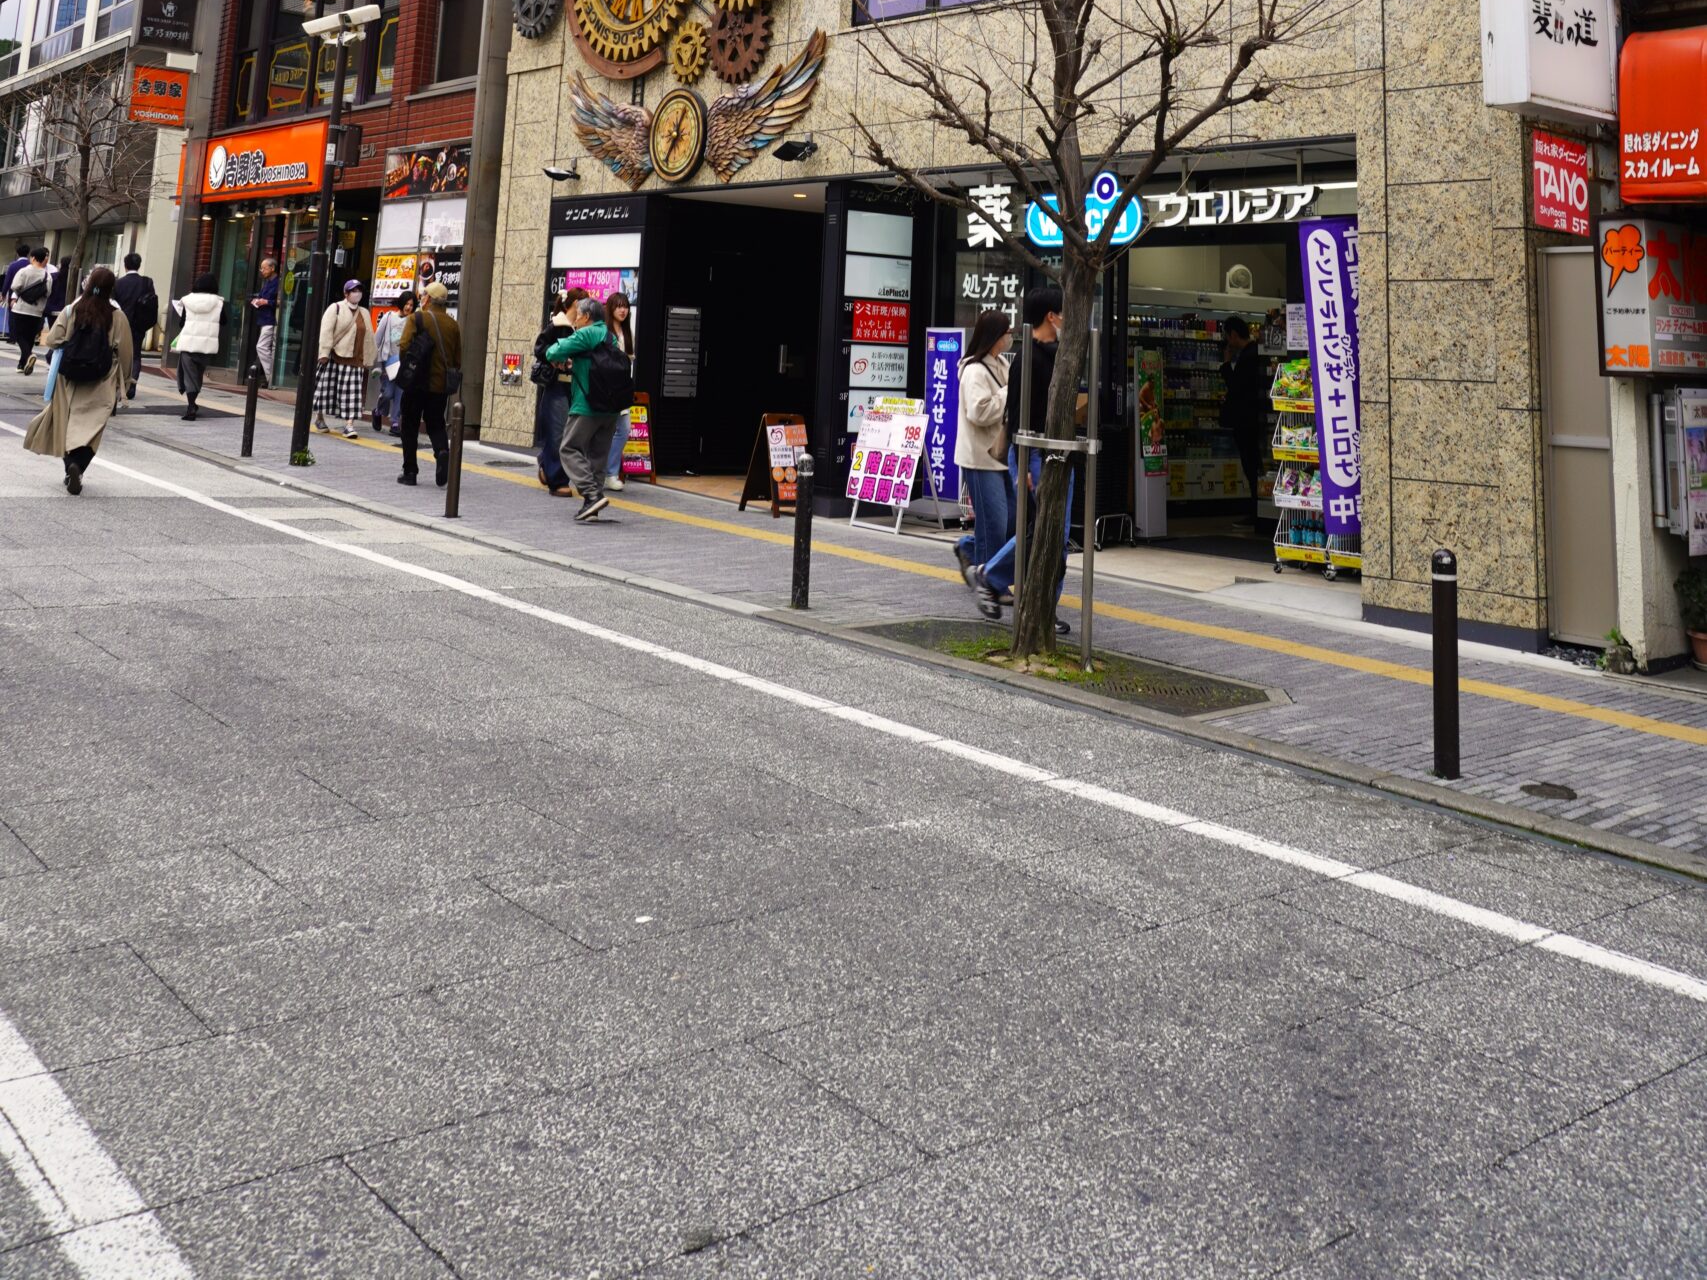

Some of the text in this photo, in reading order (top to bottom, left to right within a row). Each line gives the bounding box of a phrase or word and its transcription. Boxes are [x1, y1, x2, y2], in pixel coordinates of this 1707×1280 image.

[138, 79, 182, 99] 吉野家
[134, 109, 179, 121] YOSHINOYA
[1624, 128, 1699, 153] 隠れ家ダイニング
[1535, 139, 1588, 167] 隠れ家ダイニング
[225, 149, 265, 187] 吉野家
[261, 162, 307, 182] YOSHINOYA
[1624, 156, 1701, 179] スカイルーム
[1534, 160, 1589, 212] TAIYO
[565, 206, 630, 221] サンロイヤルビル
[967, 184, 1012, 248] 薬
[1158, 185, 1317, 228] ウエルシア
[1572, 217, 1588, 235] 5F
[588, 271, 610, 285] ¥7980
[882, 287, 909, 298] LePlus24
[844, 302, 854, 312] 5F
[856, 327, 896, 340] 美容皮膚科
[1606, 344, 1650, 368] 太陽
[871, 362, 905, 373] 生活習慣病
[871, 375, 903, 384] クリニック
[904, 425, 921, 441] 198
[931, 358, 948, 493] 処方せん受付
[853, 450, 915, 479] 2階店内
[847, 476, 909, 506] に展開中
